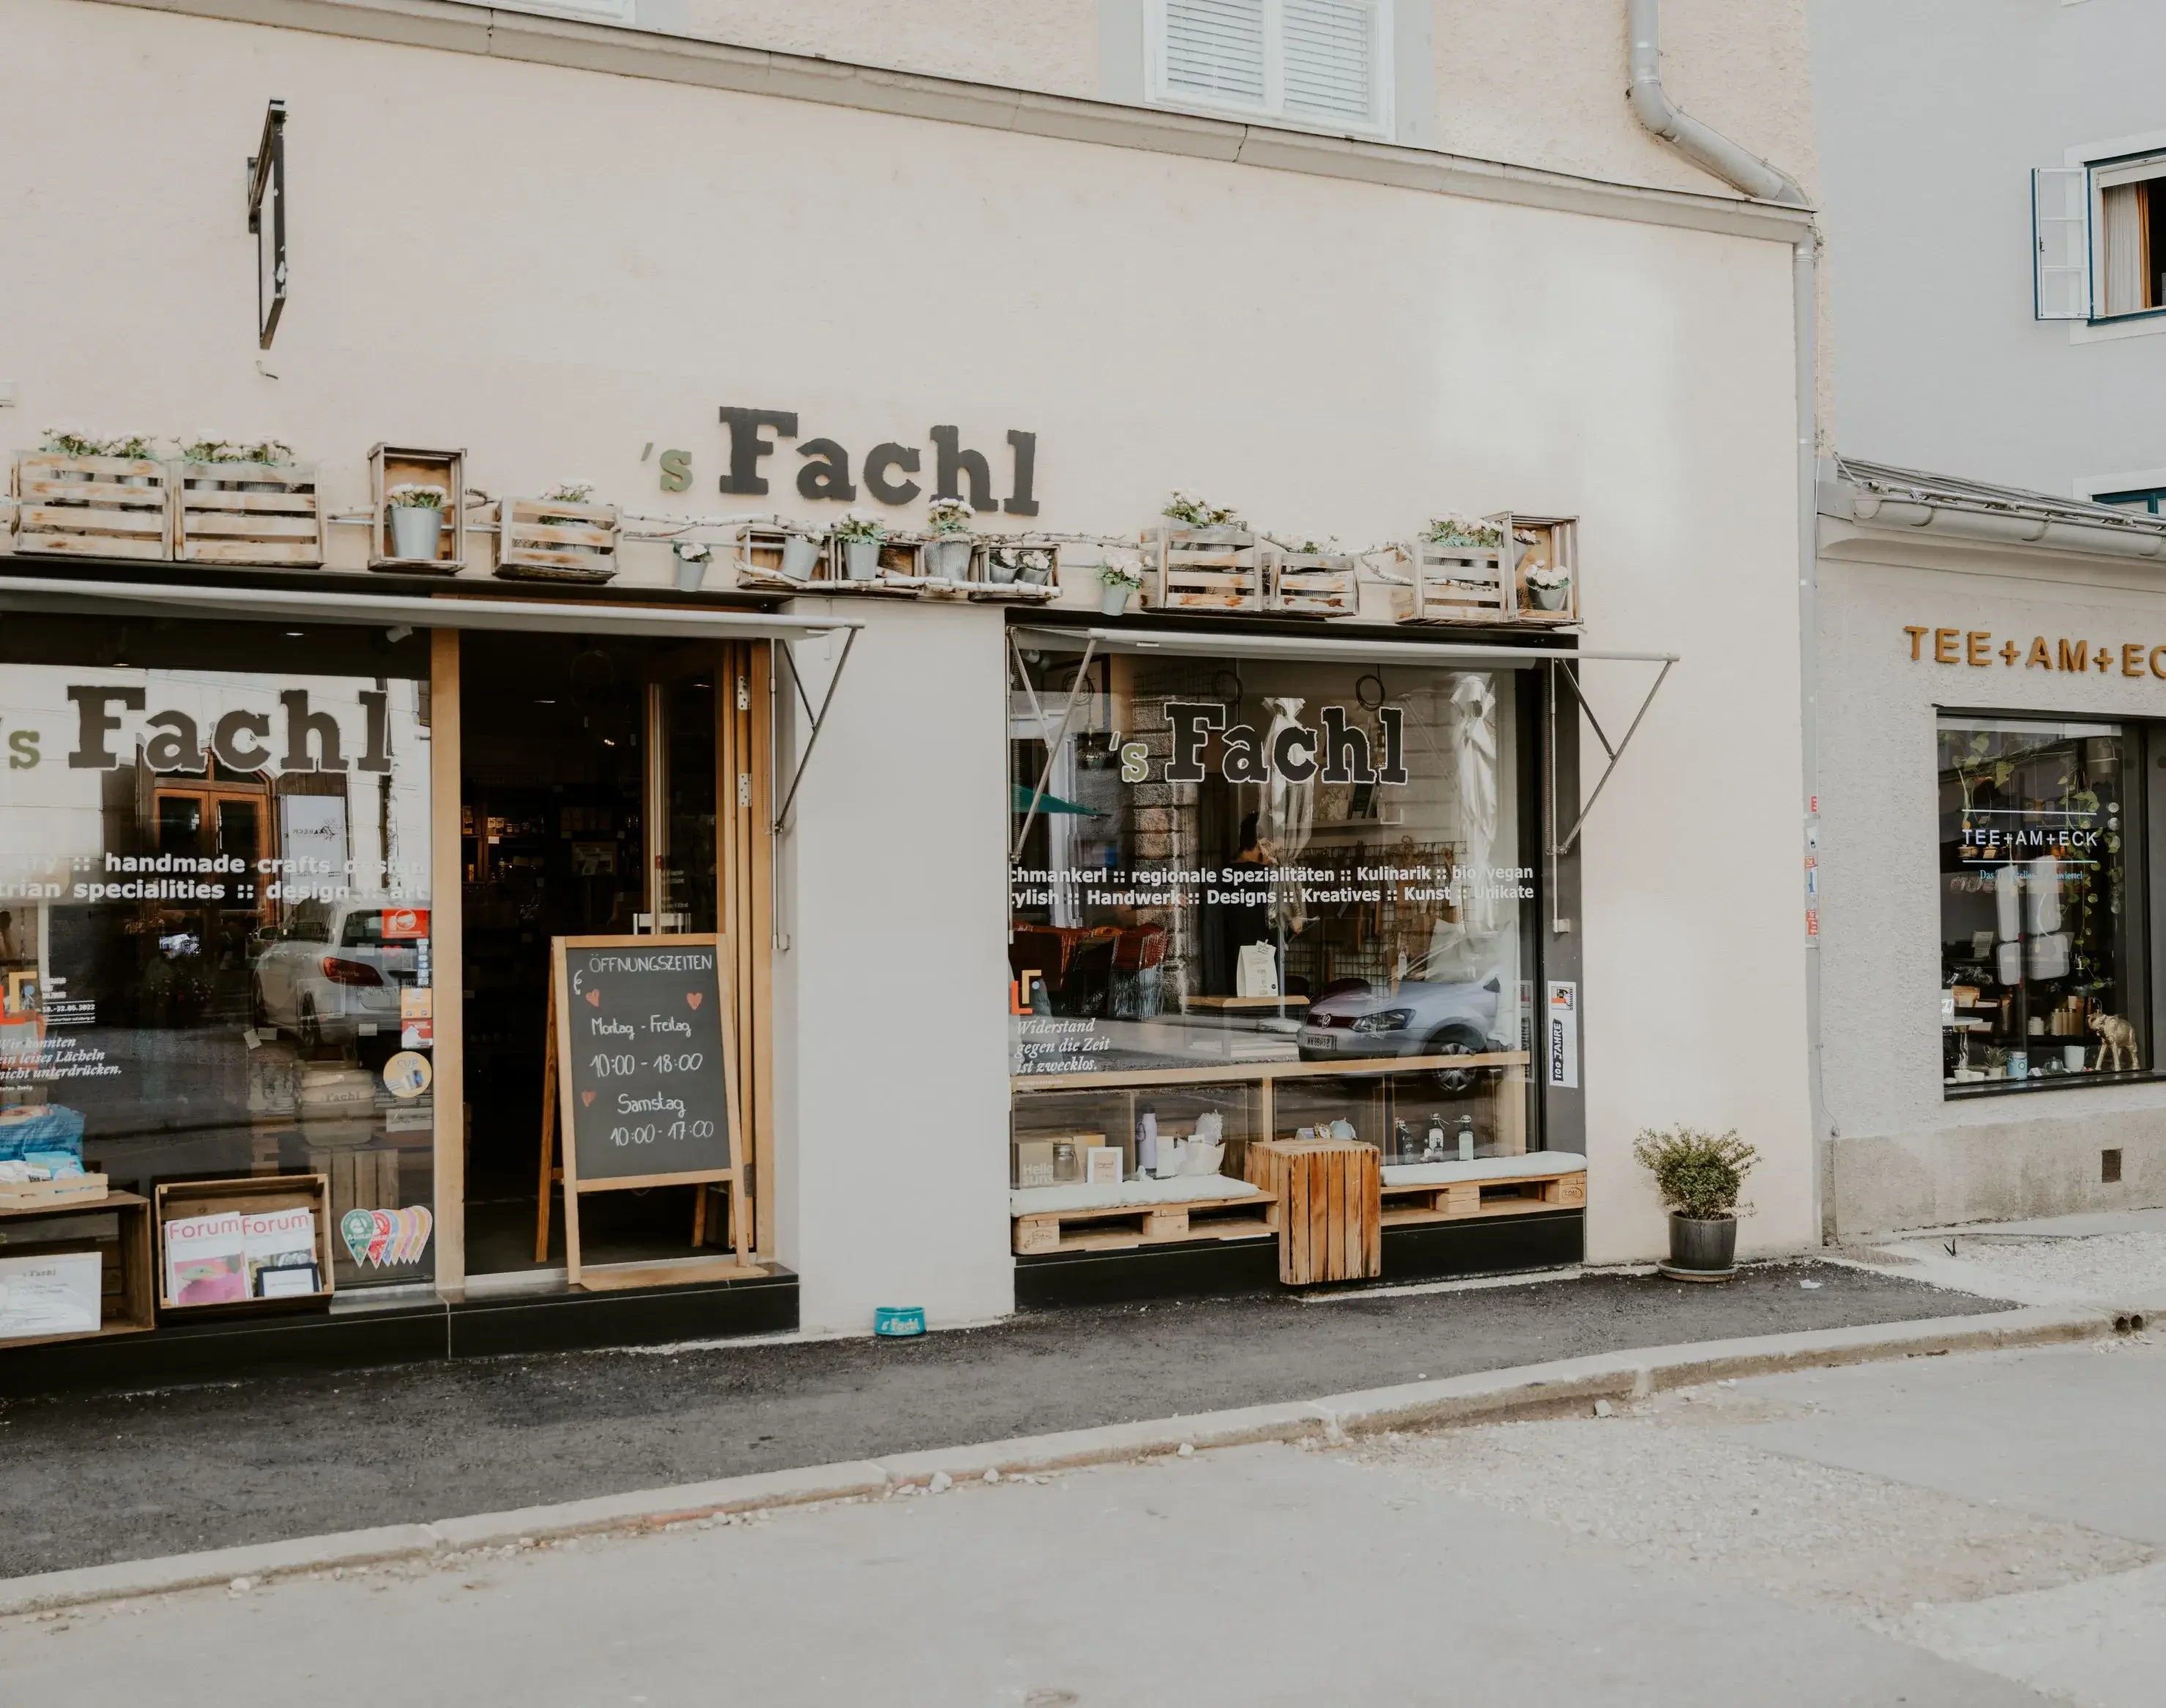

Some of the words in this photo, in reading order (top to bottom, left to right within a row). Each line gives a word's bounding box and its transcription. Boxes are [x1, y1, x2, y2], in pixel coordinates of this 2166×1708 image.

[640, 441, 693, 491] 's
[719, 406, 1039, 516] Fachl
[67, 685, 392, 773] Fachl
[1109, 731, 1148, 783] 's
[1164, 702, 1408, 786] Fachl
[1962, 829, 2097, 846] TEE+AM+ECK
[105, 852, 245, 873] handmade
[258, 855, 330, 873] crafts
[1132, 867, 1216, 886] regionale
[1222, 866, 1334, 886] Spezialitäten
[1358, 866, 1431, 881] Kulinarik
[73, 879, 226, 902] specialities
[266, 881, 351, 905] design
[1087, 889, 1182, 906] Handwerk
[1207, 889, 1276, 908] Designs
[1301, 887, 1381, 903] Kreatives
[1404, 887, 1451, 900] Kunst
[589, 952, 712, 972] ÖFFNUNGSZEITEN
[592, 1018, 635, 1040] Montag
[650, 1015, 692, 1037] Freitag
[1016, 1018, 1096, 1035] Widerstand
[1013, 1041, 1055, 1059] gegen
[1058, 1037, 1082, 1052] die
[1082, 1036, 1111, 1052] Zeit
[1553, 1022, 1563, 1060] JAHRE
[55, 1048, 105, 1062] Lächeln
[589, 1053, 635, 1078] 10:00
[653, 1053, 703, 1074] 18:00
[1016, 1058, 1035, 1073] ist
[1035, 1055, 1098, 1073] zwecklos.
[32, 1063, 122, 1078] unterdrücken.
[617, 1091, 686, 1118] Samstag
[610, 1124, 656, 1146] 10:00
[667, 1120, 714, 1140] 17:00
[1023, 1162, 1054, 1176] Hello
[169, 1219, 239, 1239] Forum
[242, 1214, 308, 1236] Forum
